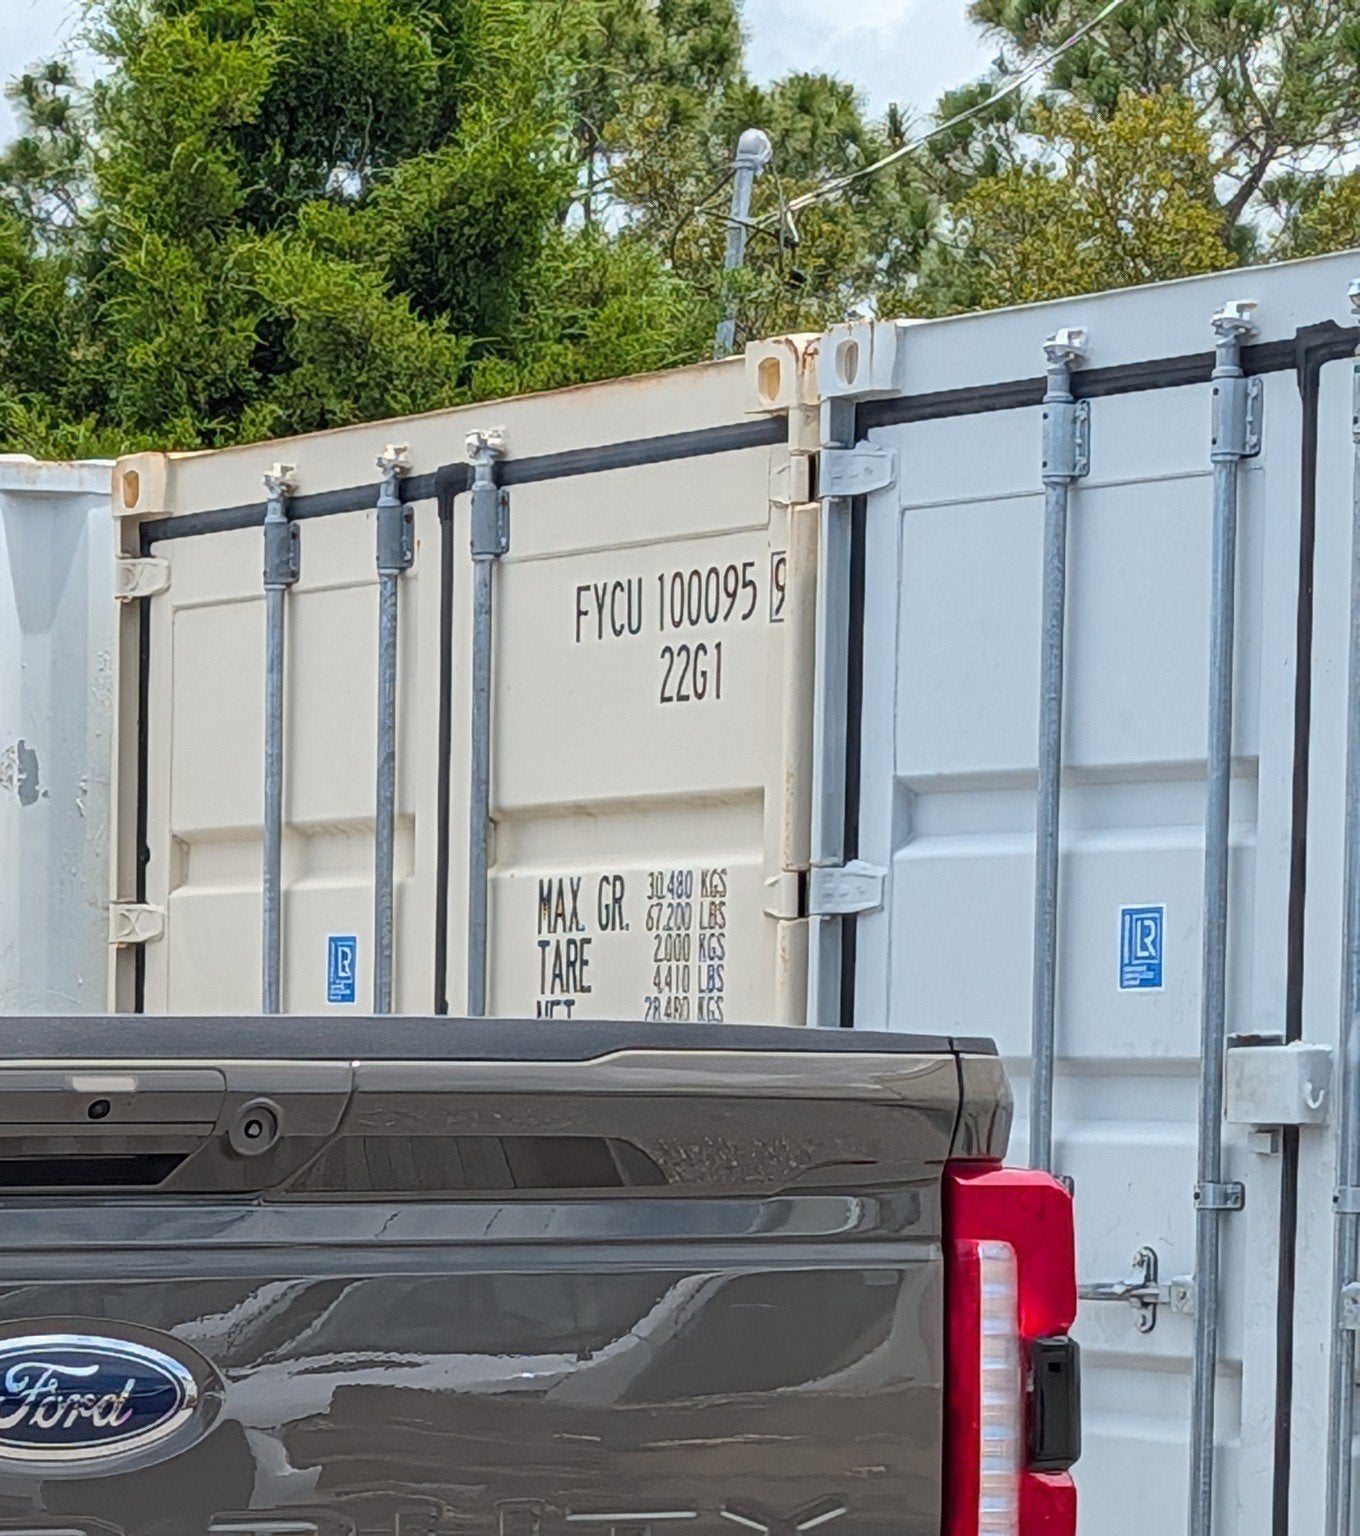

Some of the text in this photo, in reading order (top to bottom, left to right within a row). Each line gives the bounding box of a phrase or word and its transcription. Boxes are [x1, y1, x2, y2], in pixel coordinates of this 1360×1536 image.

[576, 577, 643, 642] FYCU
[657, 562, 758, 632] 100095
[660, 641, 723, 703] 22G1
[598, 875, 629, 932] GR.
[700, 868, 727, 898] KGS
[699, 901, 726, 930] LBS
[538, 938, 592, 994] TARE
[698, 933, 726, 961] KGS
[698, 964, 724, 993] LBS
